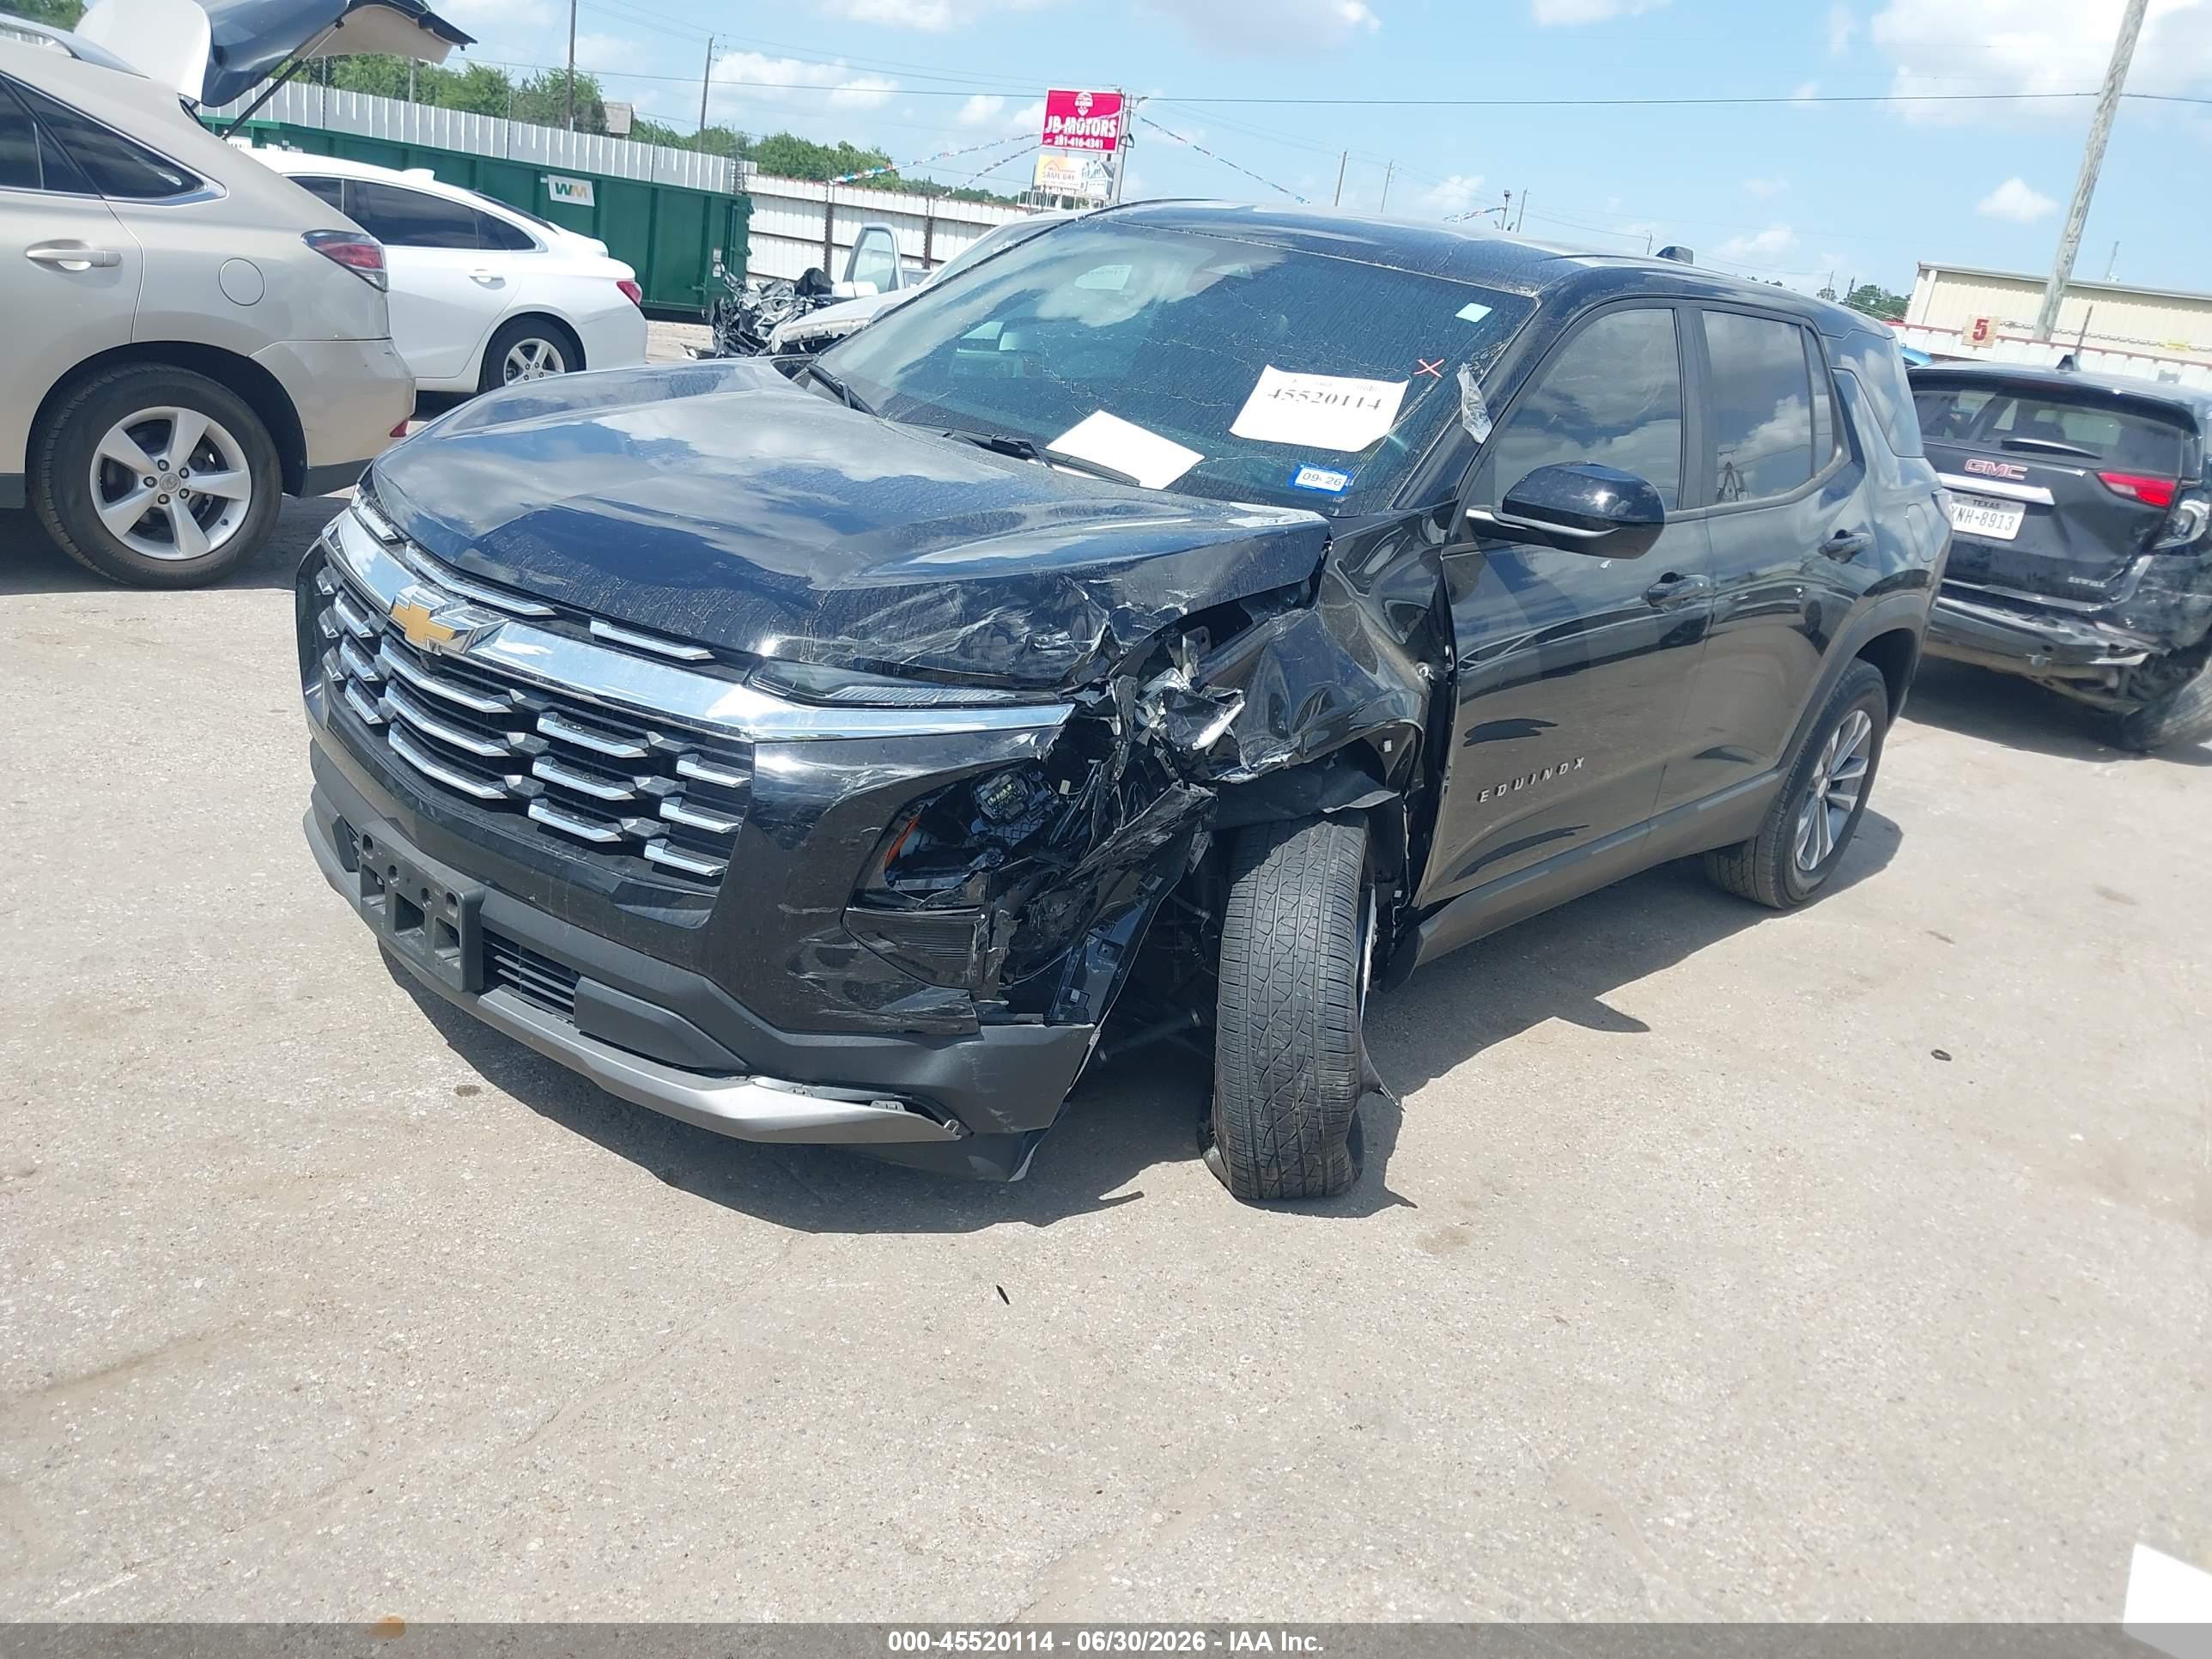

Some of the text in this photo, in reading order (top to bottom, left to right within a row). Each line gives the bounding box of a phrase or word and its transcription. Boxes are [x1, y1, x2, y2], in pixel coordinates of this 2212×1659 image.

[555, 181, 587, 198] WM
[1972, 319, 1990, 342] 5
[1267, 388, 1382, 410] 45520114
[1965, 459, 2028, 480] GMC
[1972, 499, 2001, 509] TEXAS
[1478, 757, 1584, 804] EQUINOX
